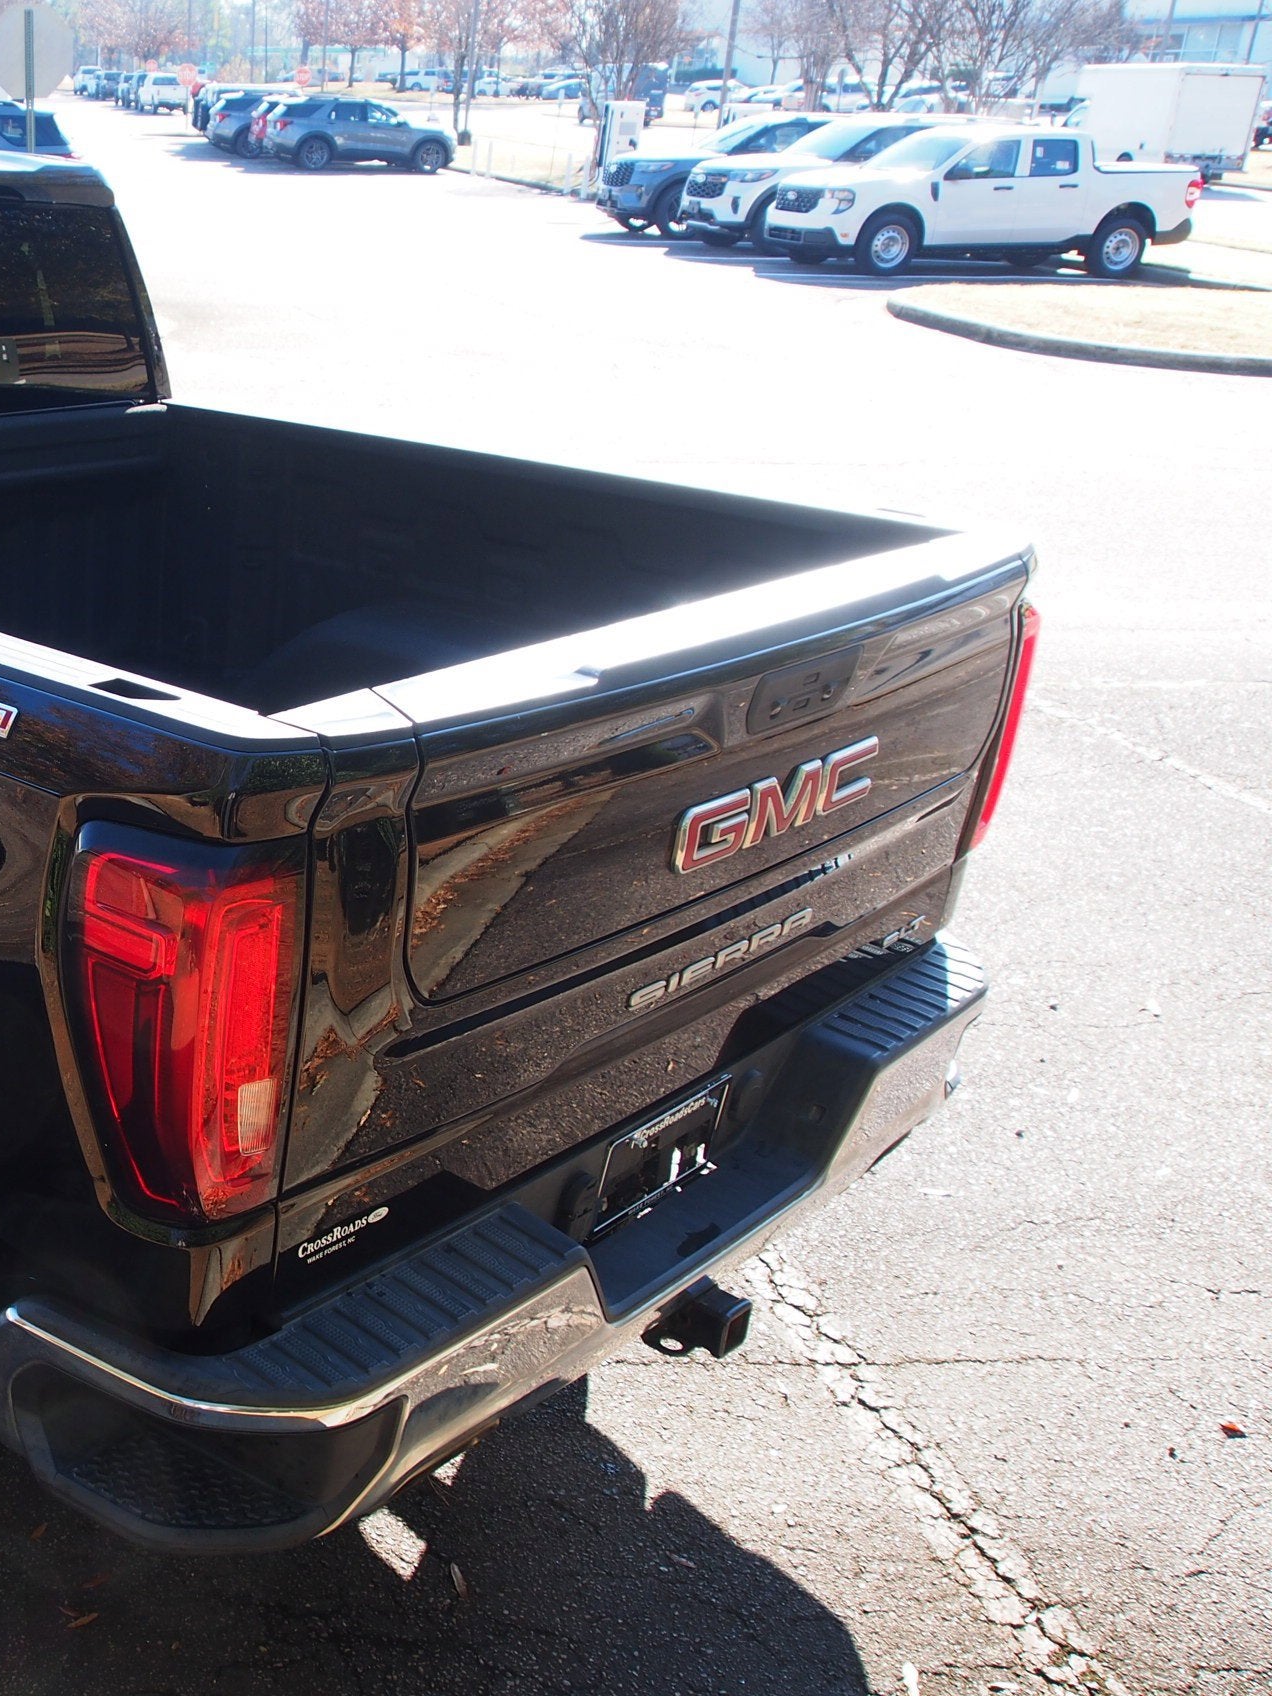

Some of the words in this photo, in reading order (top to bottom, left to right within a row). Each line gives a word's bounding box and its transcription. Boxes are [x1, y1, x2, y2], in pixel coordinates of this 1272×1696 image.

[672, 735, 879, 874] GMC
[628, 907, 813, 1011] SIERRA
[306, 1248, 325, 1265] WAKE
[347, 1235, 356, 1245] NC
